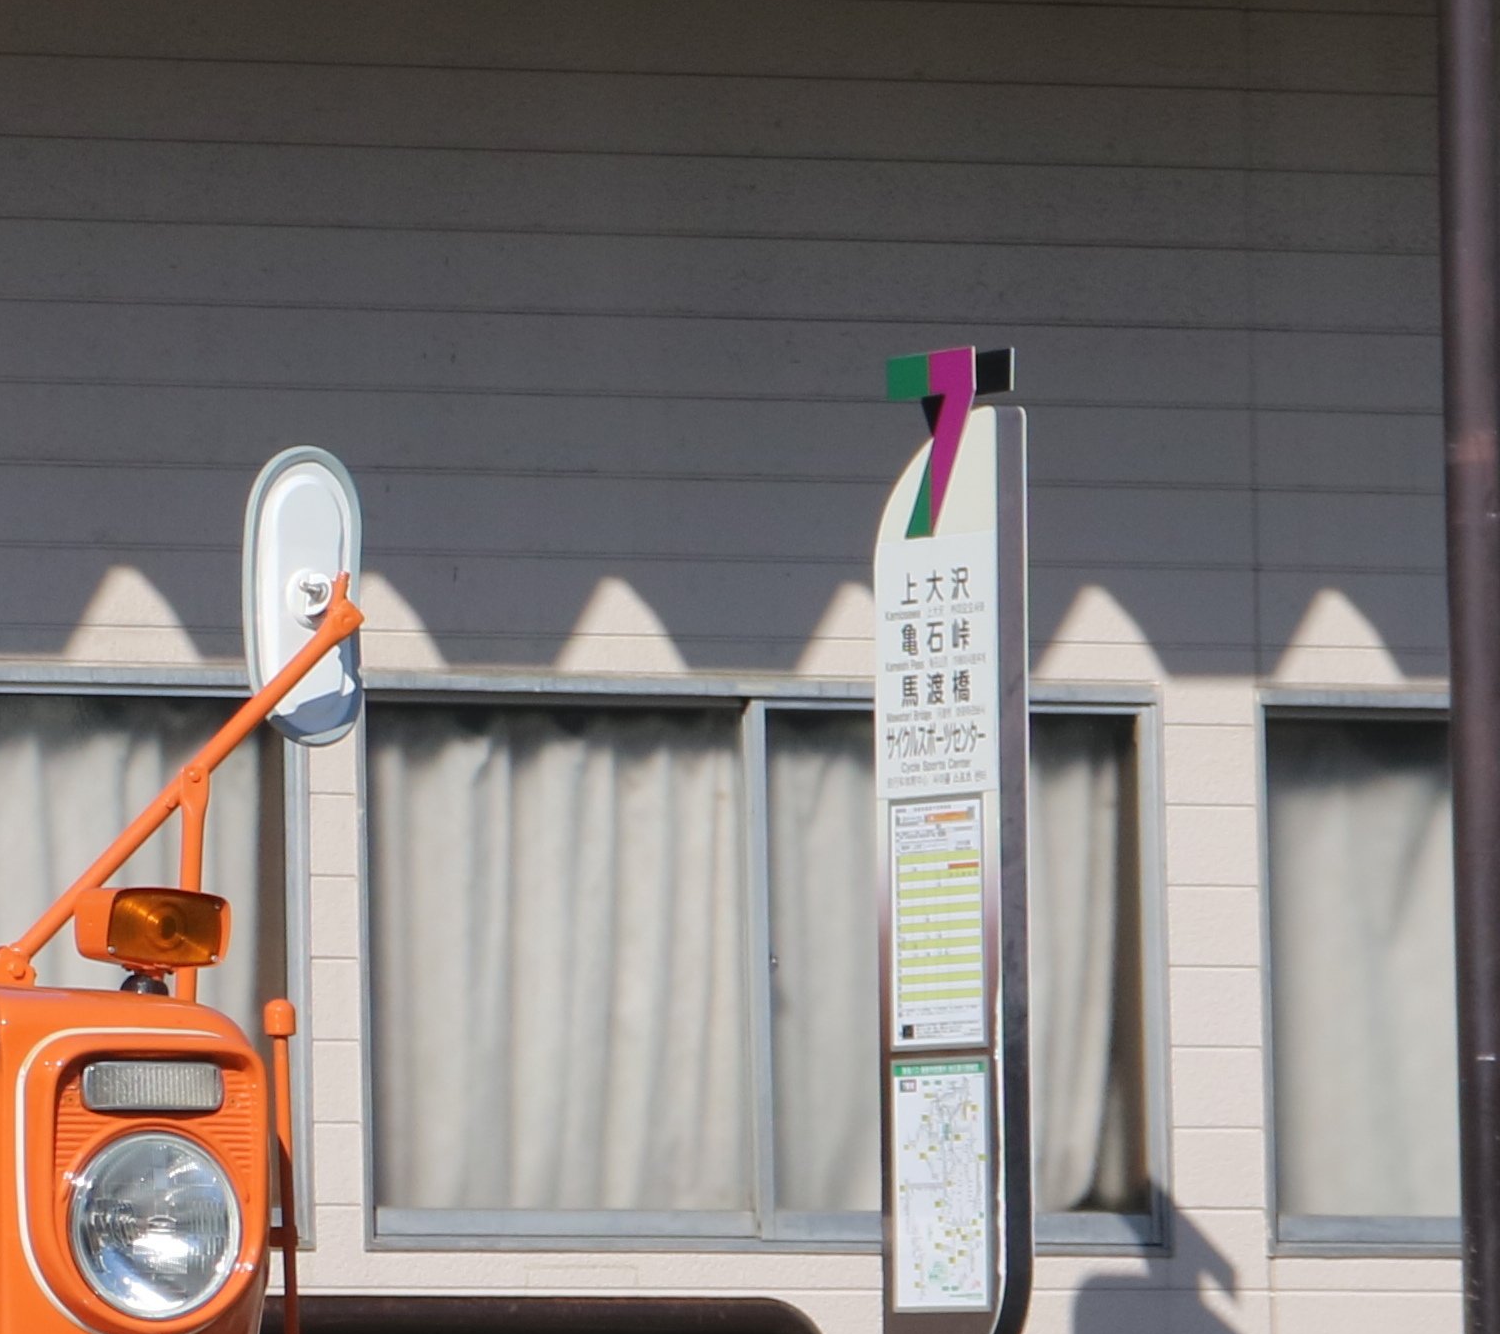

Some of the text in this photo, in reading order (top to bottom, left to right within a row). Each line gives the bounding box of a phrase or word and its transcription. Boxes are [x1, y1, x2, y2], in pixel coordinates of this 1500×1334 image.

[900, 567, 970, 606] 上大沢
[901, 617, 971, 657] 亀石峠
[901, 669, 971, 708] 馬渡橋
[886, 720, 987, 760] サイクルスポーツセンター
